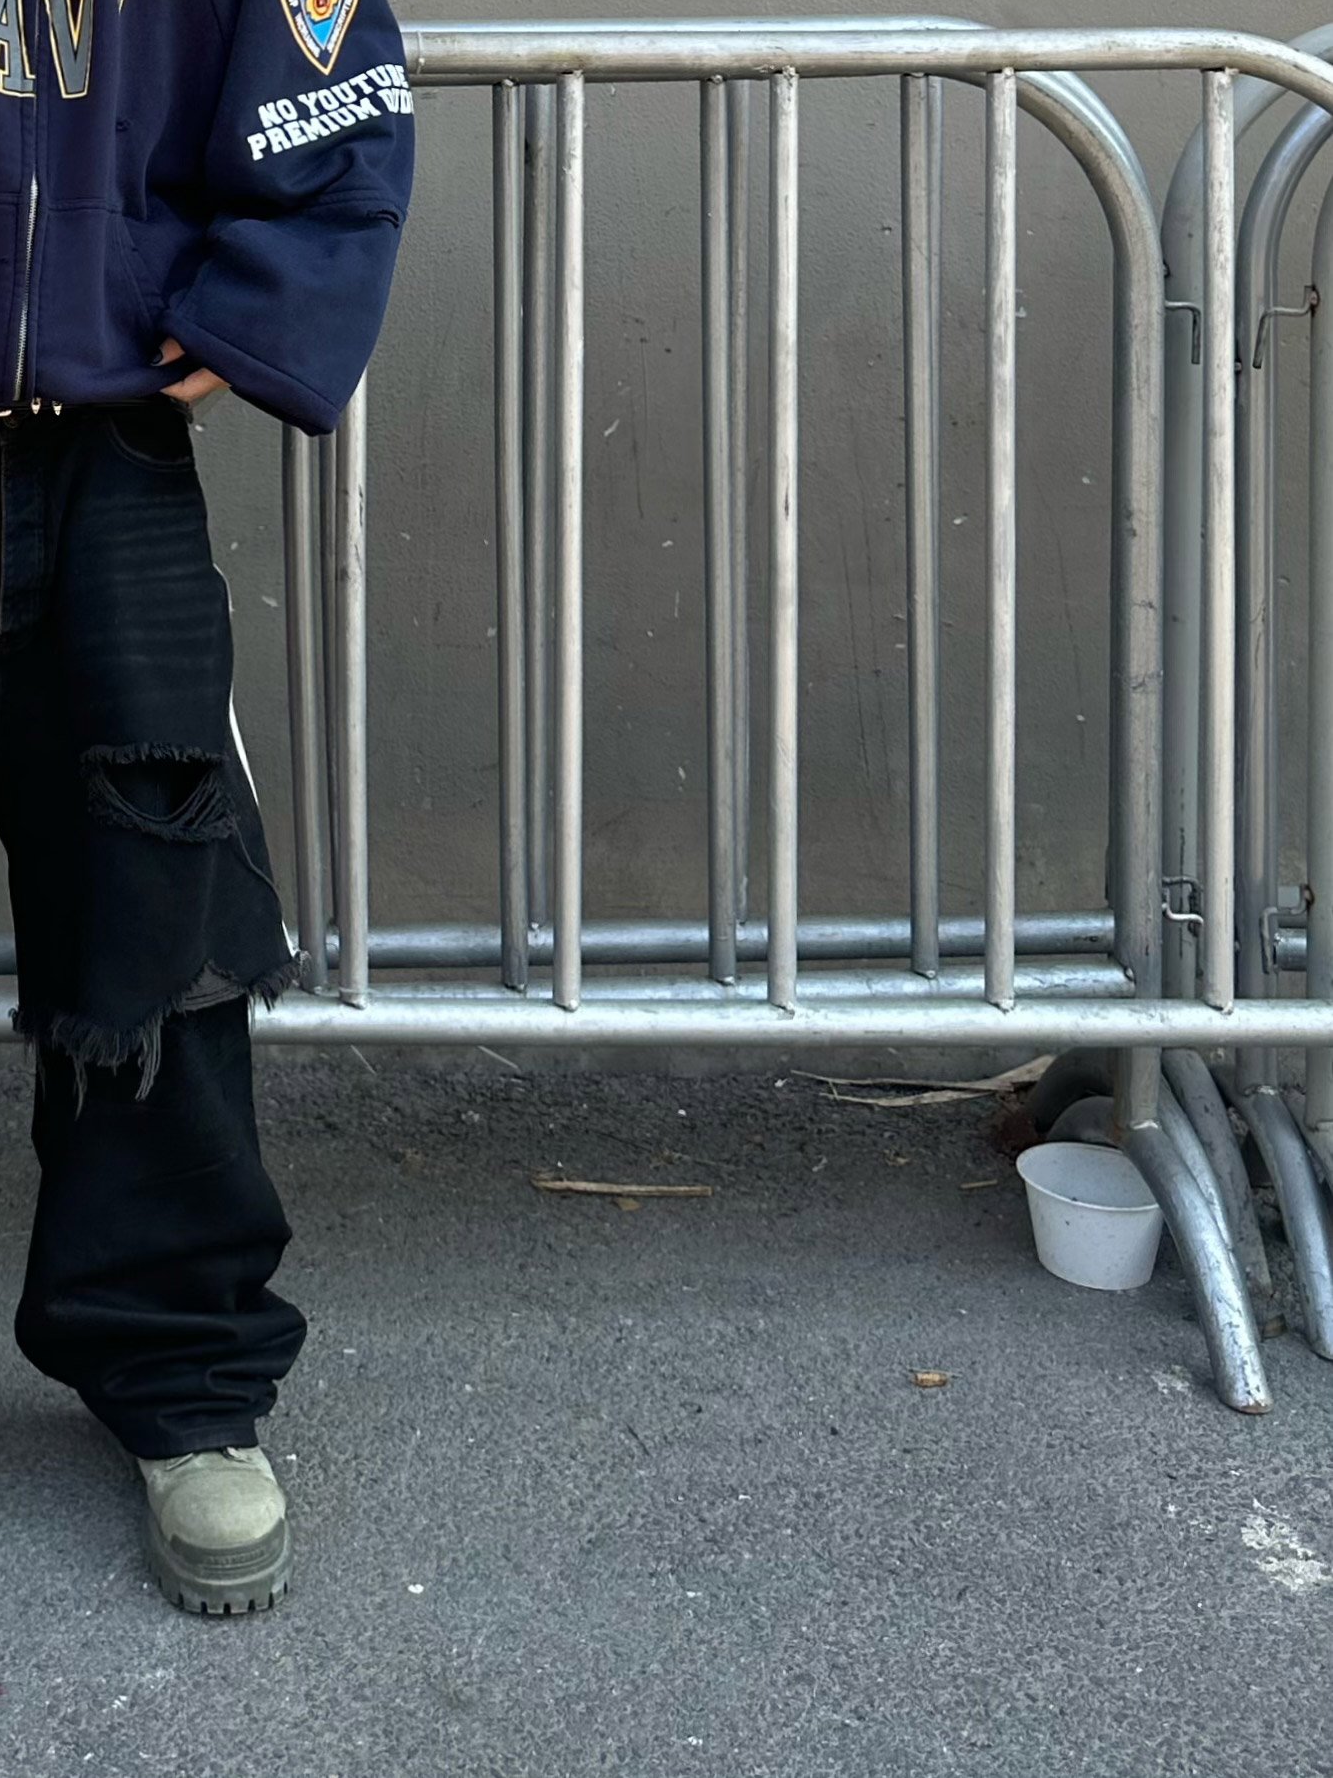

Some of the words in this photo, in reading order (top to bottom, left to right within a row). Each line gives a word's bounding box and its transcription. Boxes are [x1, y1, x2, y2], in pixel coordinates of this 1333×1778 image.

[257, 98, 299, 129] NO
[297, 63, 409, 117] YOUTUBE
[246, 97, 382, 161] PREMIUM
